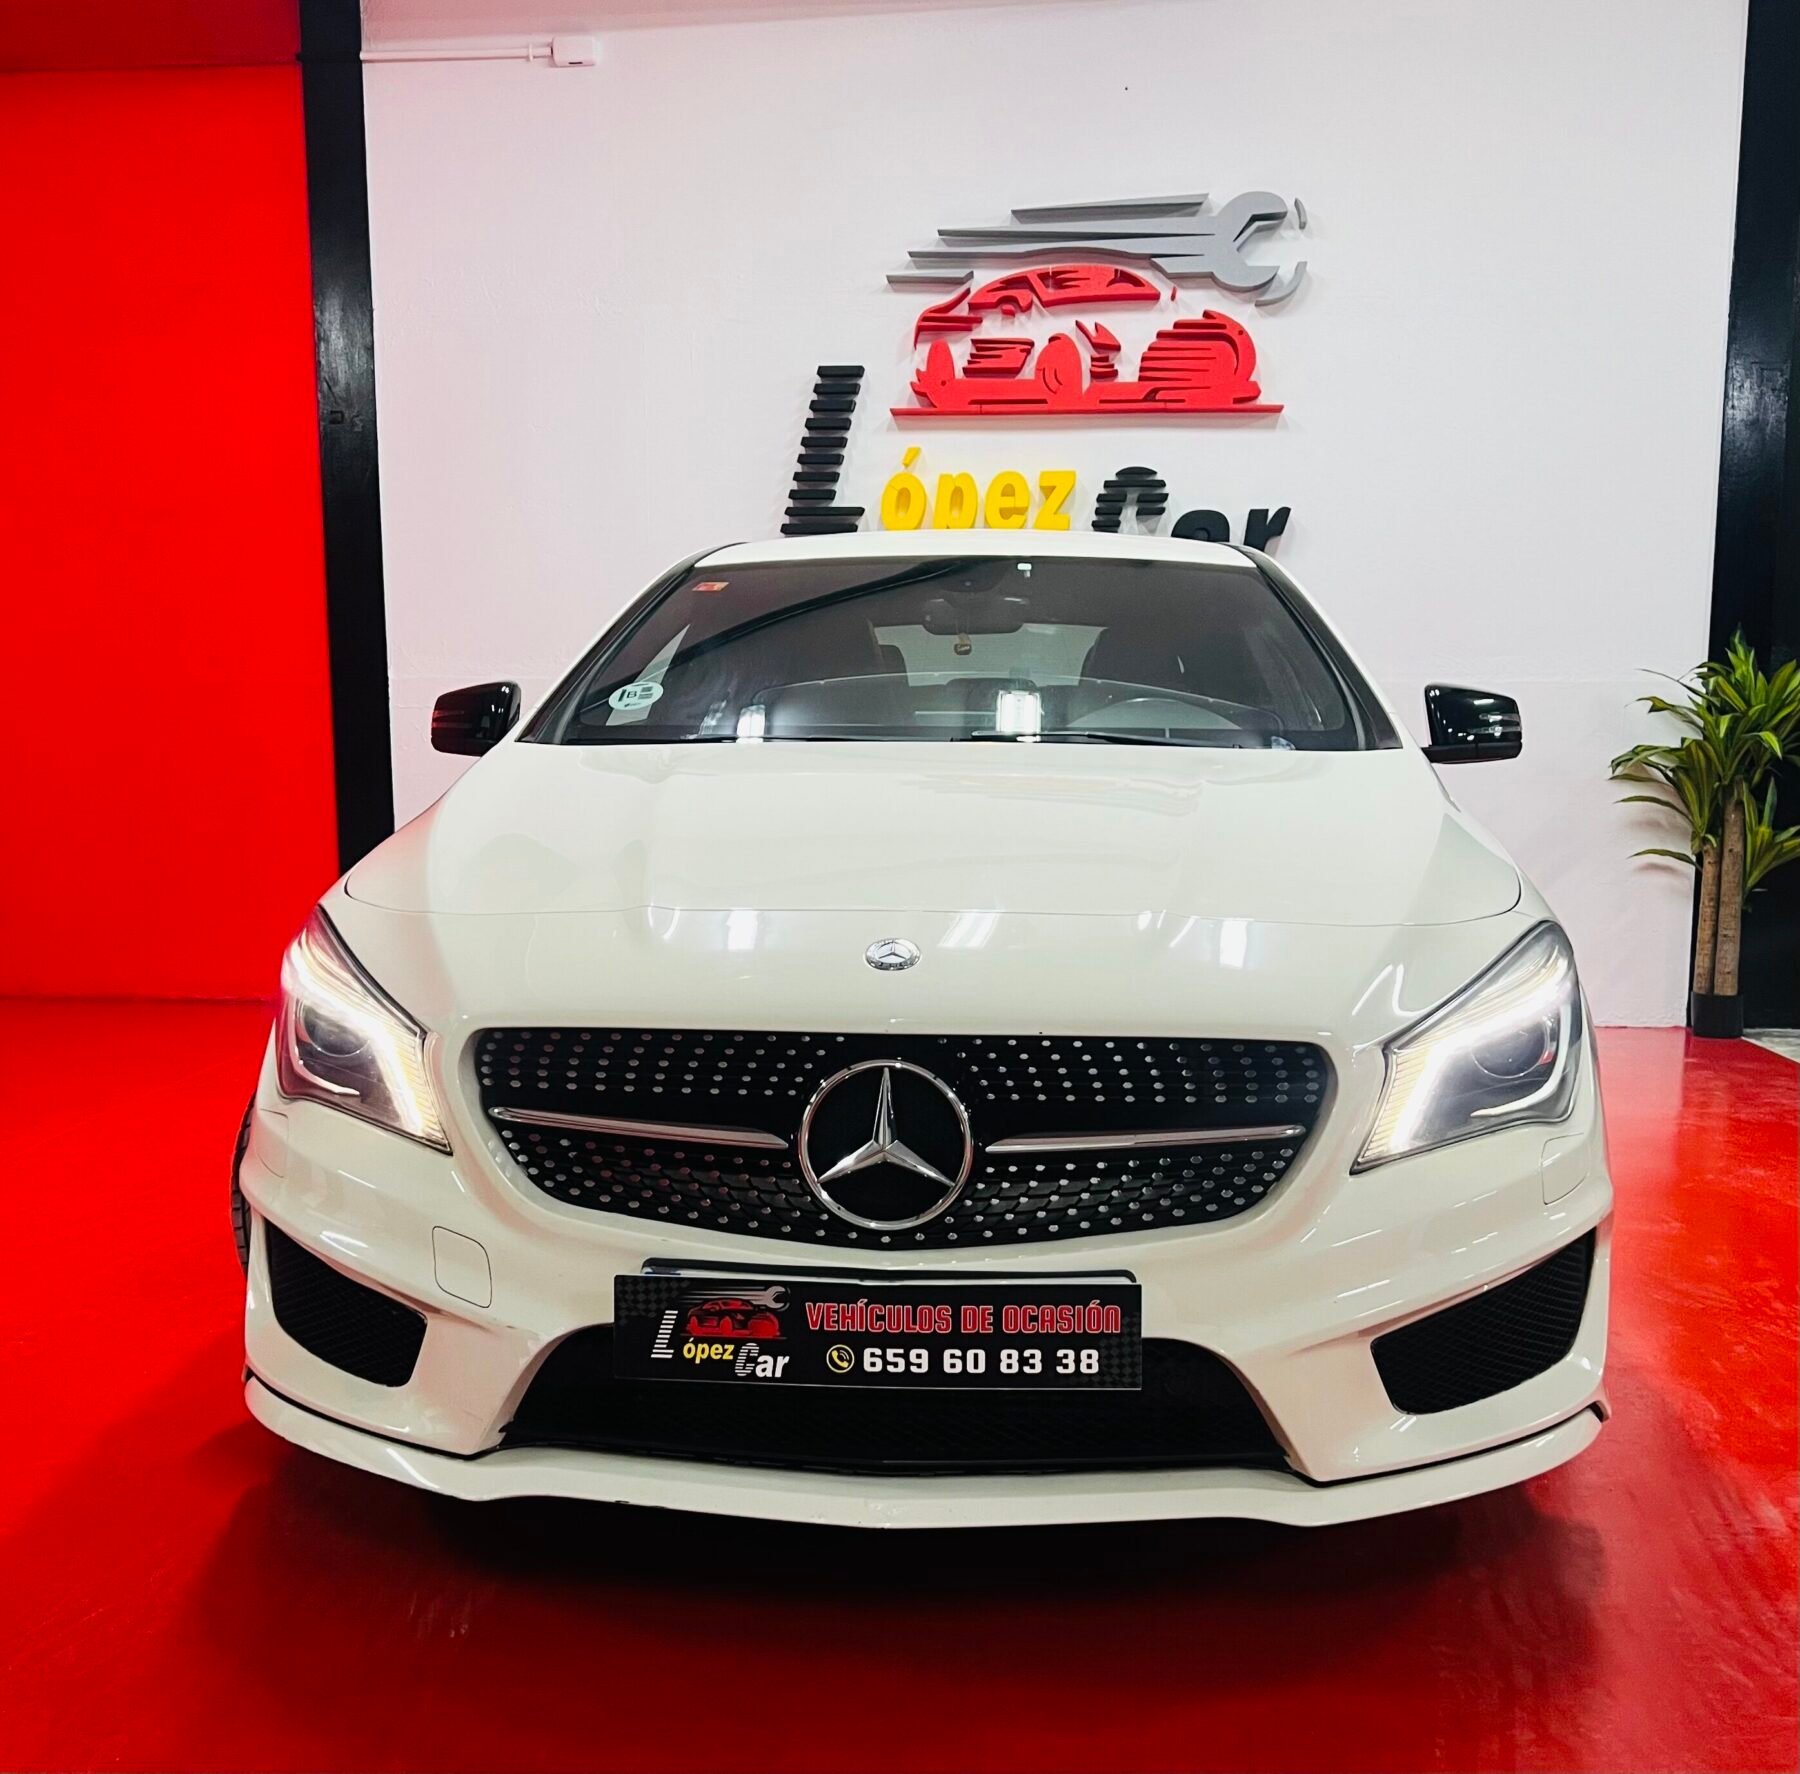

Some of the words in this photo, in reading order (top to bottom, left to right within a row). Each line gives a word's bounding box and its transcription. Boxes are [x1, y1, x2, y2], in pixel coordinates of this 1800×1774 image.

[780, 365, 1076, 533] López
[805, 1298, 952, 1333] VEHÍCULOS
[961, 1305, 993, 1333] DE
[1002, 1299, 1121, 1333] OCASIÓN
[651, 1310, 734, 1364] López
[735, 1343, 790, 1377] Car
[863, 1348, 929, 1373] 659
[943, 1349, 986, 1374] 60
[1000, 1349, 1042, 1374] 83
[1056, 1349, 1099, 1374] 38
